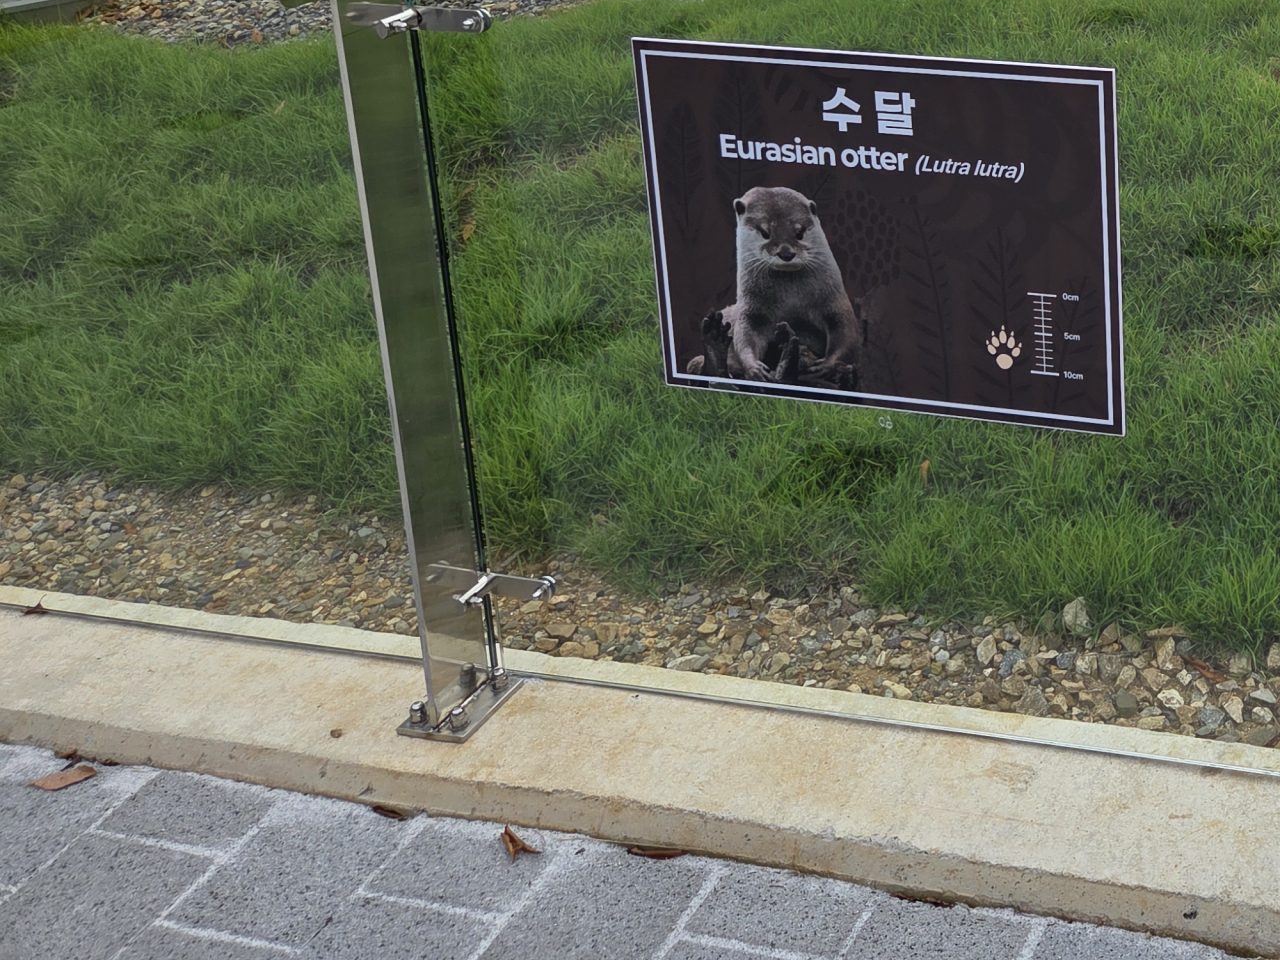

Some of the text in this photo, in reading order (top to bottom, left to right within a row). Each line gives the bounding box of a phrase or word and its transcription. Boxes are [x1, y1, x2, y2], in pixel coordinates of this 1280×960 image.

[719, 133, 1025, 183] Eurasian otter (Lutra lutra)
[1062, 292, 1079, 302] 0cm
[1063, 332, 1080, 341] 5cm
[1063, 371, 1084, 380] 10cm
